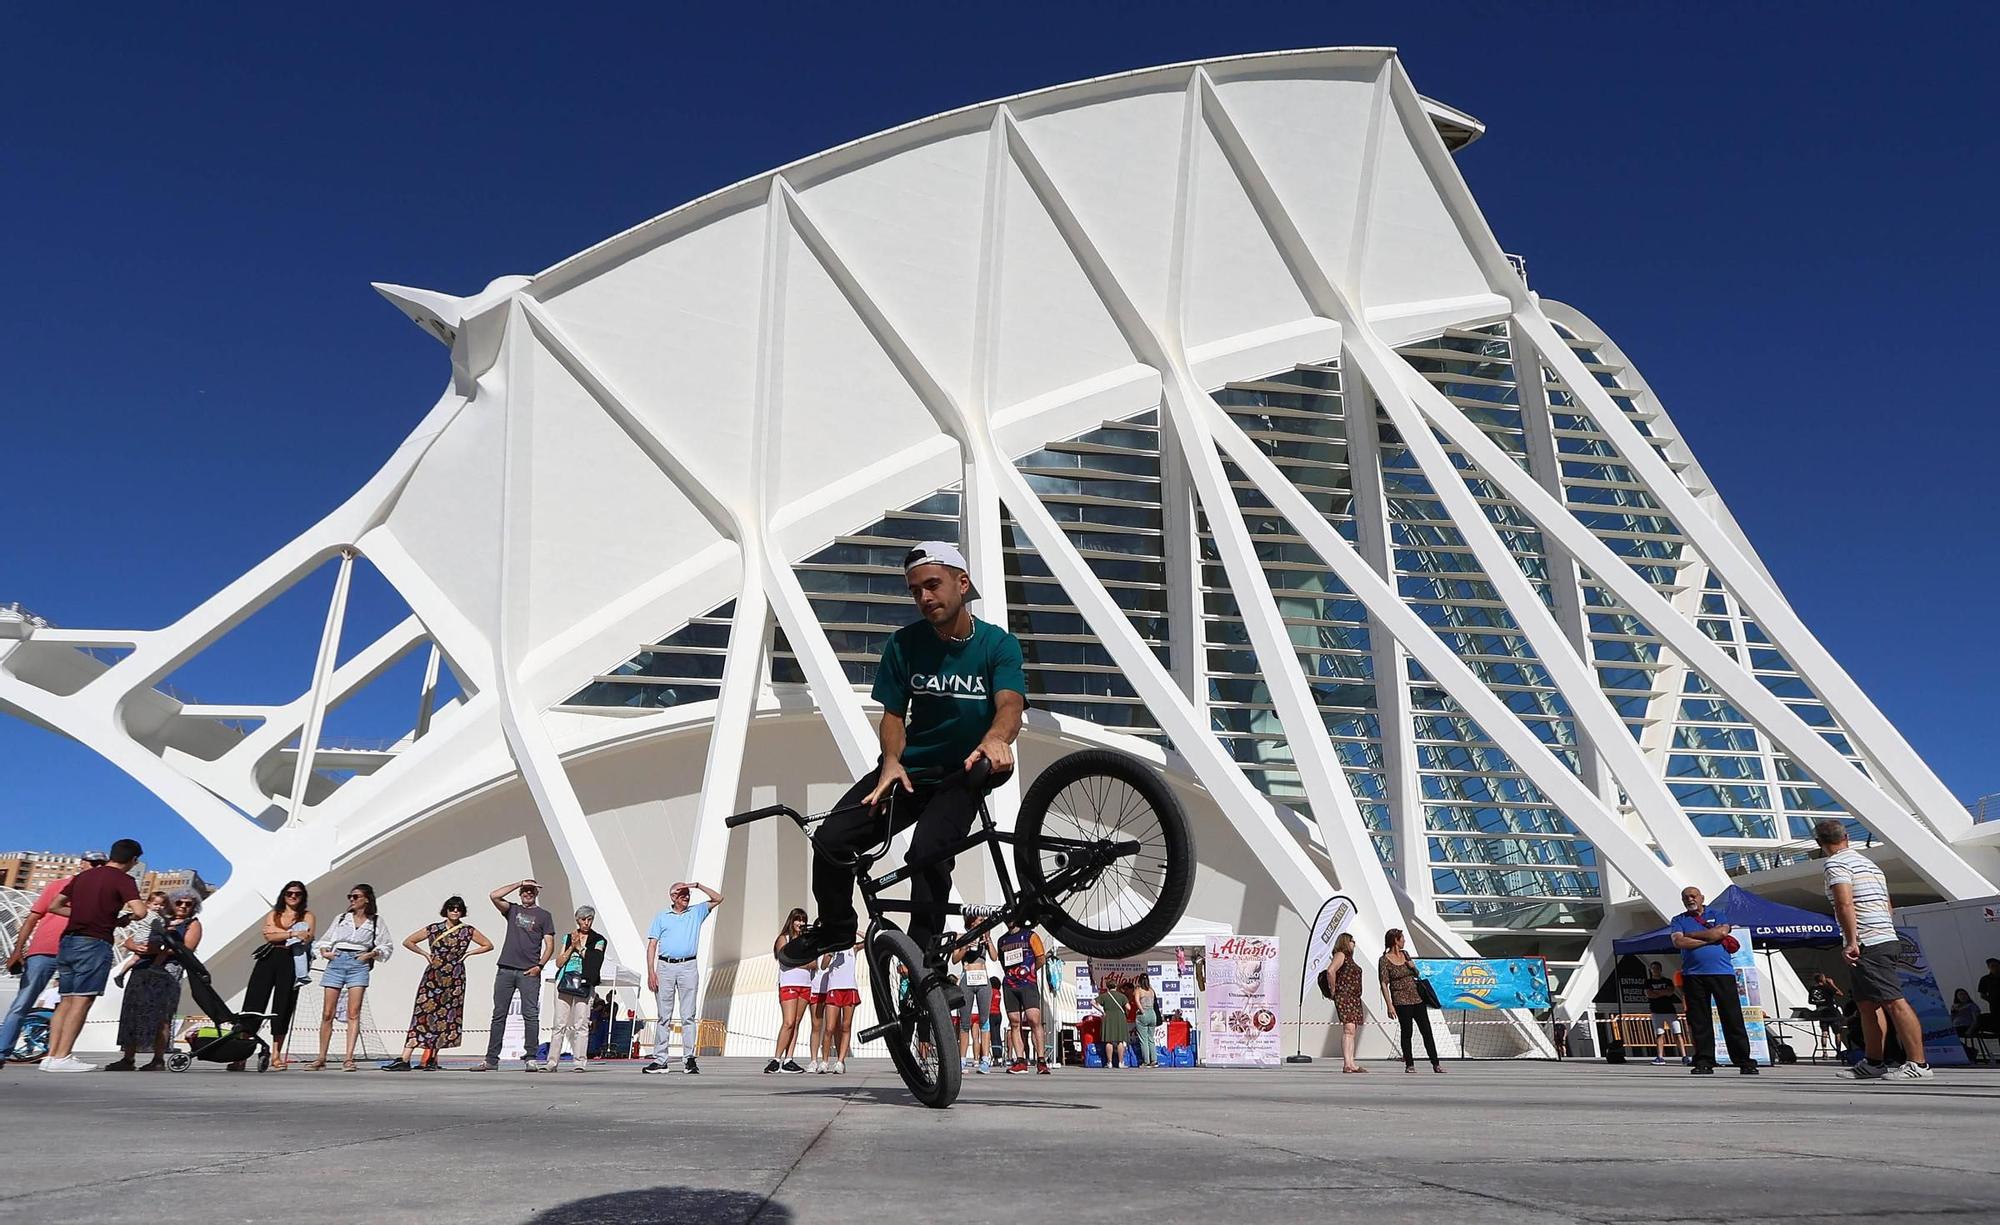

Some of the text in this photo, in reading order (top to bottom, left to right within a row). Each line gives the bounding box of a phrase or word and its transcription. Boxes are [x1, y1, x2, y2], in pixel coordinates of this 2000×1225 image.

[1775, 925, 1834, 934] WATERPOLO
[1220, 938, 1277, 959] Atlantis
[1455, 977, 1496, 985] TURIA
